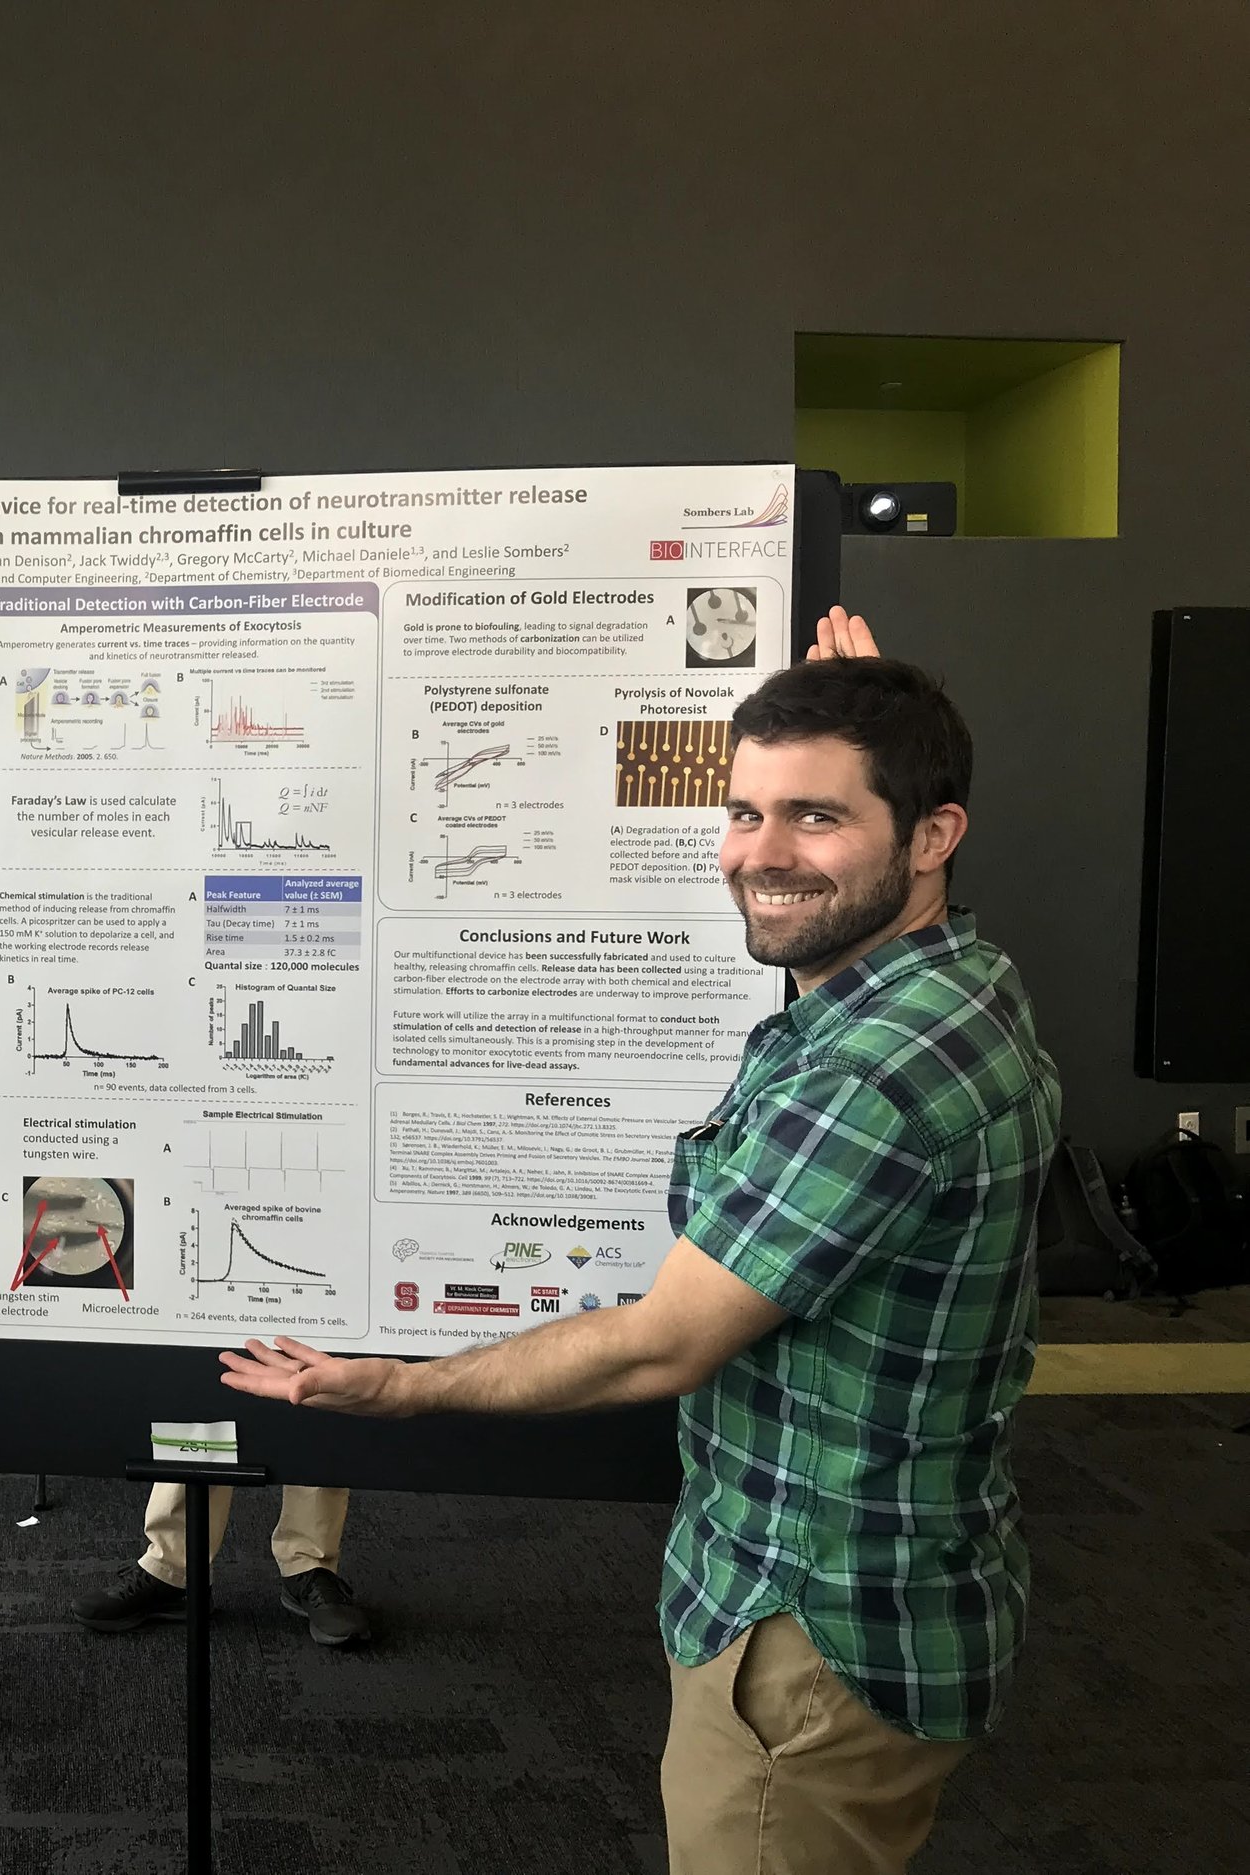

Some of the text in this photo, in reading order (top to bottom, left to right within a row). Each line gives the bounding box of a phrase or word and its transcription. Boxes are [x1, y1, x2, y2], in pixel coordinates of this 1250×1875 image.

[47, 496, 76, 514] for
[84, 492, 178, 514] real-time
[181, 490, 281, 512] detection
[289, 491, 311, 510] of
[317, 487, 502, 508] neurotransmitter
[509, 484, 587, 504] release
[683, 506, 754, 516] Sombers Lab
[11, 526, 131, 544] mammalian
[138, 523, 251, 544] chromaffin
[258, 522, 304, 541] cells
[311, 522, 329, 539] in
[337, 520, 411, 539] culture
[651, 541, 787, 559] BIOINTERFACE
[79, 554, 106, 566] Jack
[177, 553, 229, 567] Gregory
[302, 549, 354, 561] Michael
[432, 546, 457, 559] and
[462, 546, 499, 558] Leslie
[75, 597, 146, 610] Detection
[151, 596, 184, 610] with
[189, 594, 287, 609] Carbon-Fiber
[291, 592, 363, 607] Electrode
[406, 589, 654, 606] Modification of Gold Electrodes
[60, 620, 301, 635] Amperometric Measurements of Exocytosis
[424, 684, 549, 697] Polystyrene sulfonate
[614, 686, 734, 700] Pyrolysis of Novolak
[430, 700, 542, 713] (PEDOT) deposition
[640, 703, 706, 714] Photoresist
[65, 795, 86, 805] Law
[89, 795, 97, 805] is
[100, 795, 125, 805] used
[128, 795, 176, 805] calculate
[16, 810, 169, 821] the number of moles in each
[30, 827, 154, 837] vesicular release event.
[285, 879, 359, 889] Analyzed average
[206, 890, 226, 898] Peak
[284, 891, 307, 899] value
[320, 891, 342, 900] SEM)
[206, 904, 246, 912] Halfwidth
[206, 919, 274, 928] Tau (Decay time)
[206, 933, 223, 941] Rise
[459, 929, 689, 944] Conclusions and Future Work
[204, 961, 242, 970] Quantal
[244, 961, 262, 970] size
[270, 961, 308, 971] 120,000
[310, 962, 359, 971] molecules
[525, 1092, 610, 1107] References
[23, 1117, 136, 1129] Electrical stimulation
[22, 1133, 78, 1143] conducted
[81, 1134, 109, 1146] using
[23, 1149, 98, 1160] tungsten wire.
[491, 1212, 644, 1231] Acknowledgements
[504, 1243, 543, 1257] PINE
[595, 1246, 621, 1258] ACS
[38, 1292, 59, 1302] stim
[82, 1303, 159, 1315] Microelectrode
[530, 1295, 559, 1312] CMI
[1, 1305, 48, 1316] electrode
[379, 1326, 497, 1340] This project is funded by the
